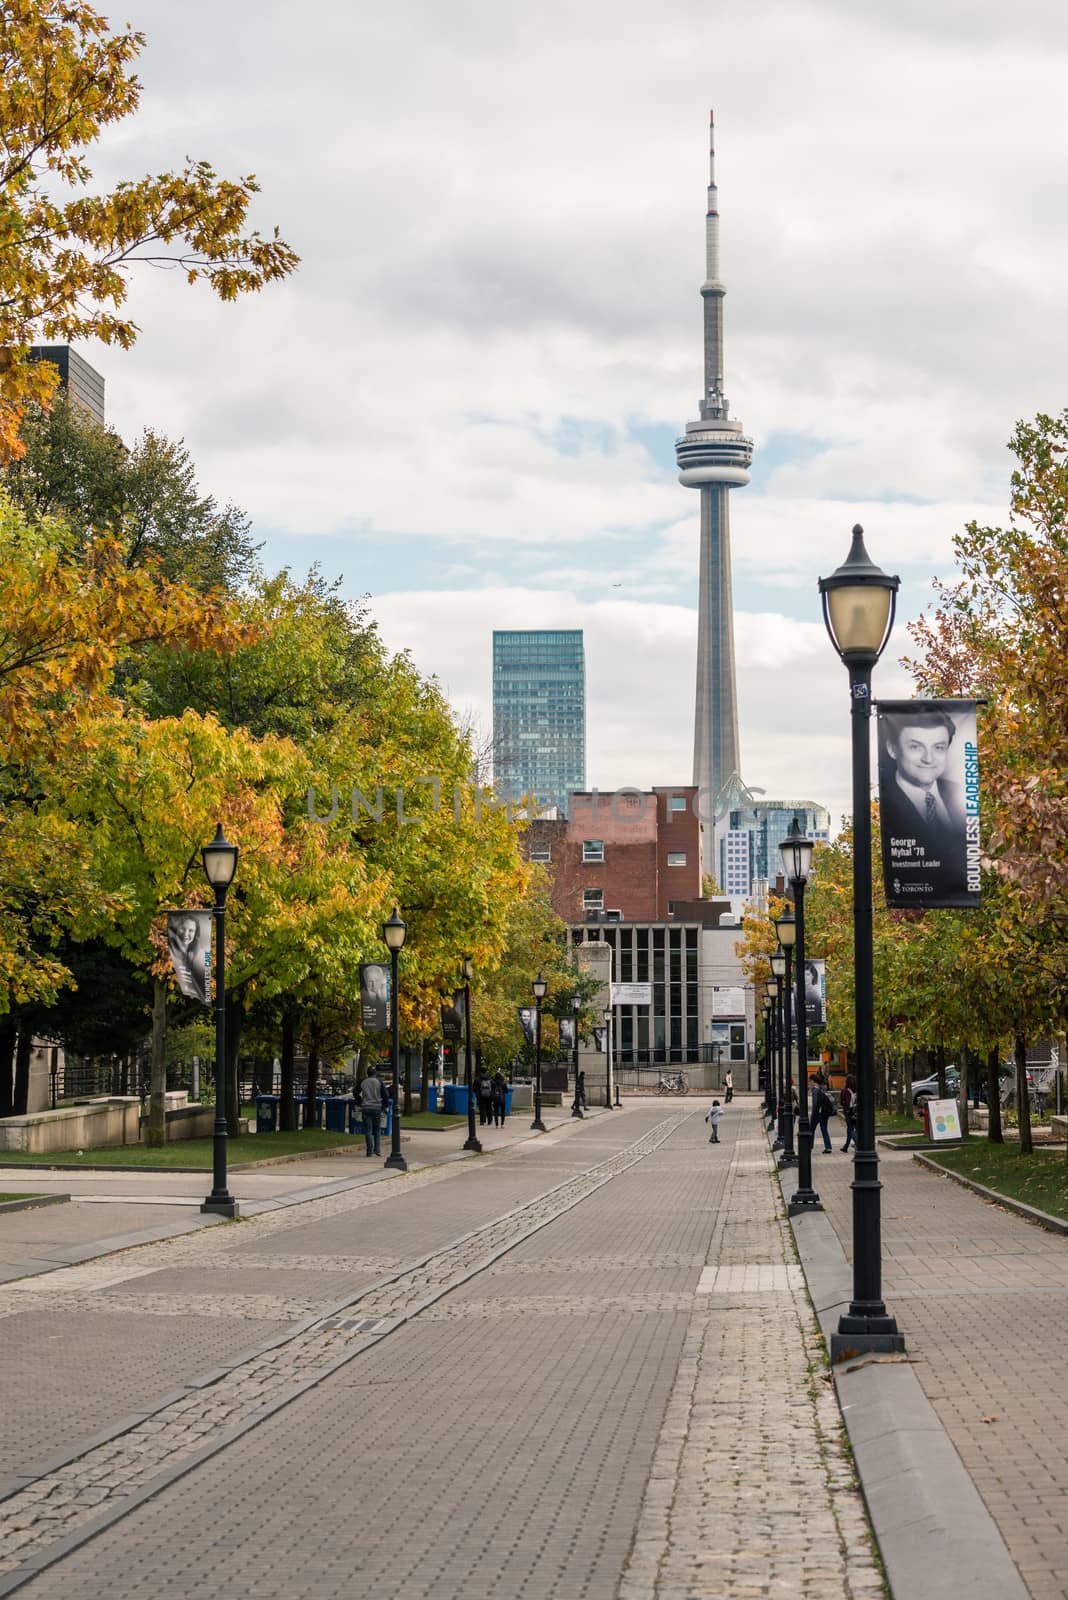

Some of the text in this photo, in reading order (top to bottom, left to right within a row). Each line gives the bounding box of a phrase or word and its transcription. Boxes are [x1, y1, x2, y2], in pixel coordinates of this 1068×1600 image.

[964, 741, 982, 892] BOUNDLESS LEADERSHIP
[890, 837, 917, 848] George
[891, 847, 912, 858] Myhal
